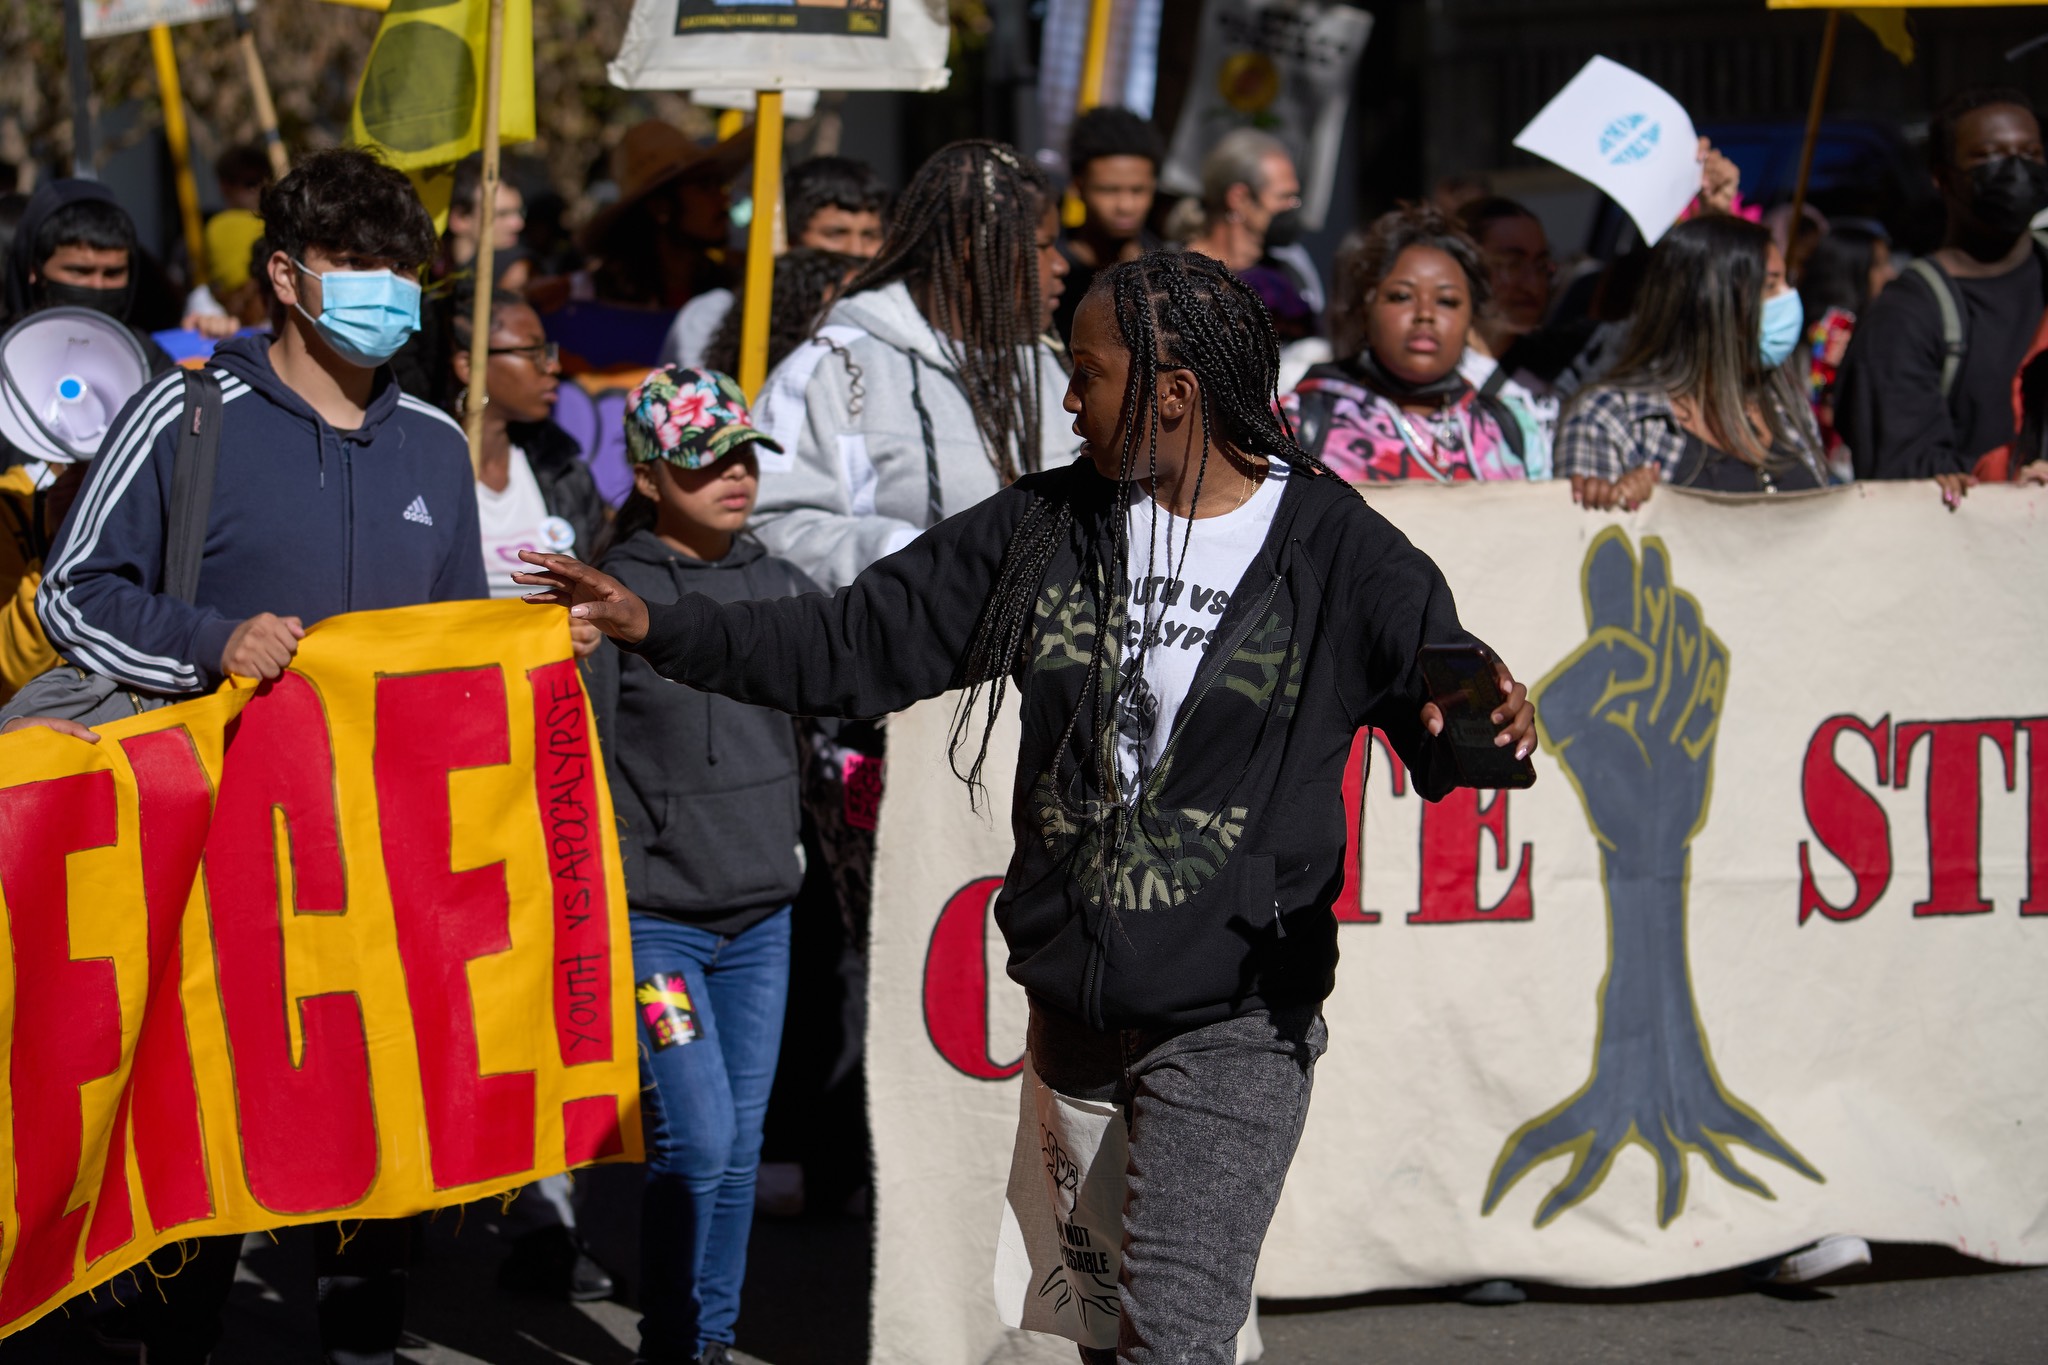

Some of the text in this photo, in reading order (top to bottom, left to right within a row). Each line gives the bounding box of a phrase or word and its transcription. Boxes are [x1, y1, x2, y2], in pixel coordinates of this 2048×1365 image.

[402, 510, 433, 526] adidas
[1189, 583, 1231, 616] VS
[547, 680, 590, 883] APOCALYPSE
[560, 952, 603, 1051] YOUTH
[1064, 1223, 1091, 1247] NOT
